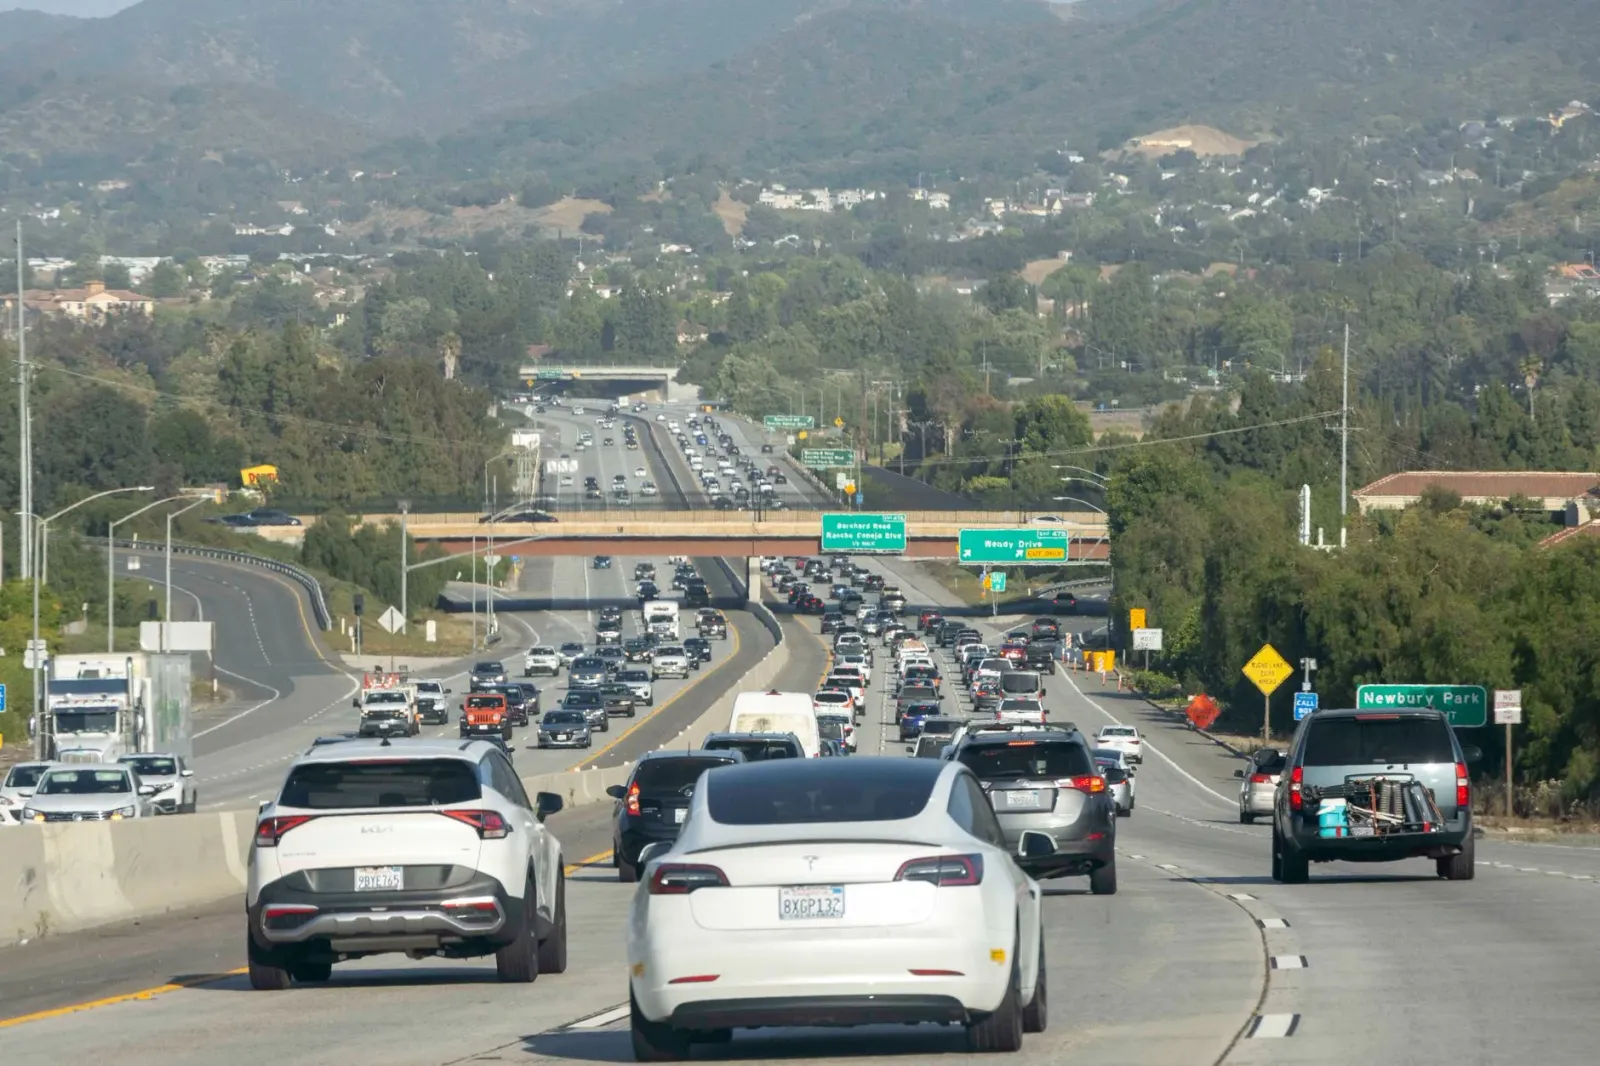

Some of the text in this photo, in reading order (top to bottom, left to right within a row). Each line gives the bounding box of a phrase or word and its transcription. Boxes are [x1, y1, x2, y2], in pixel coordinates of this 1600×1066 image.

[856, 532, 883, 540] Conejo
[984, 540, 1043, 549] Wendy Drive
[1363, 691, 1480, 706] Newbury Park
